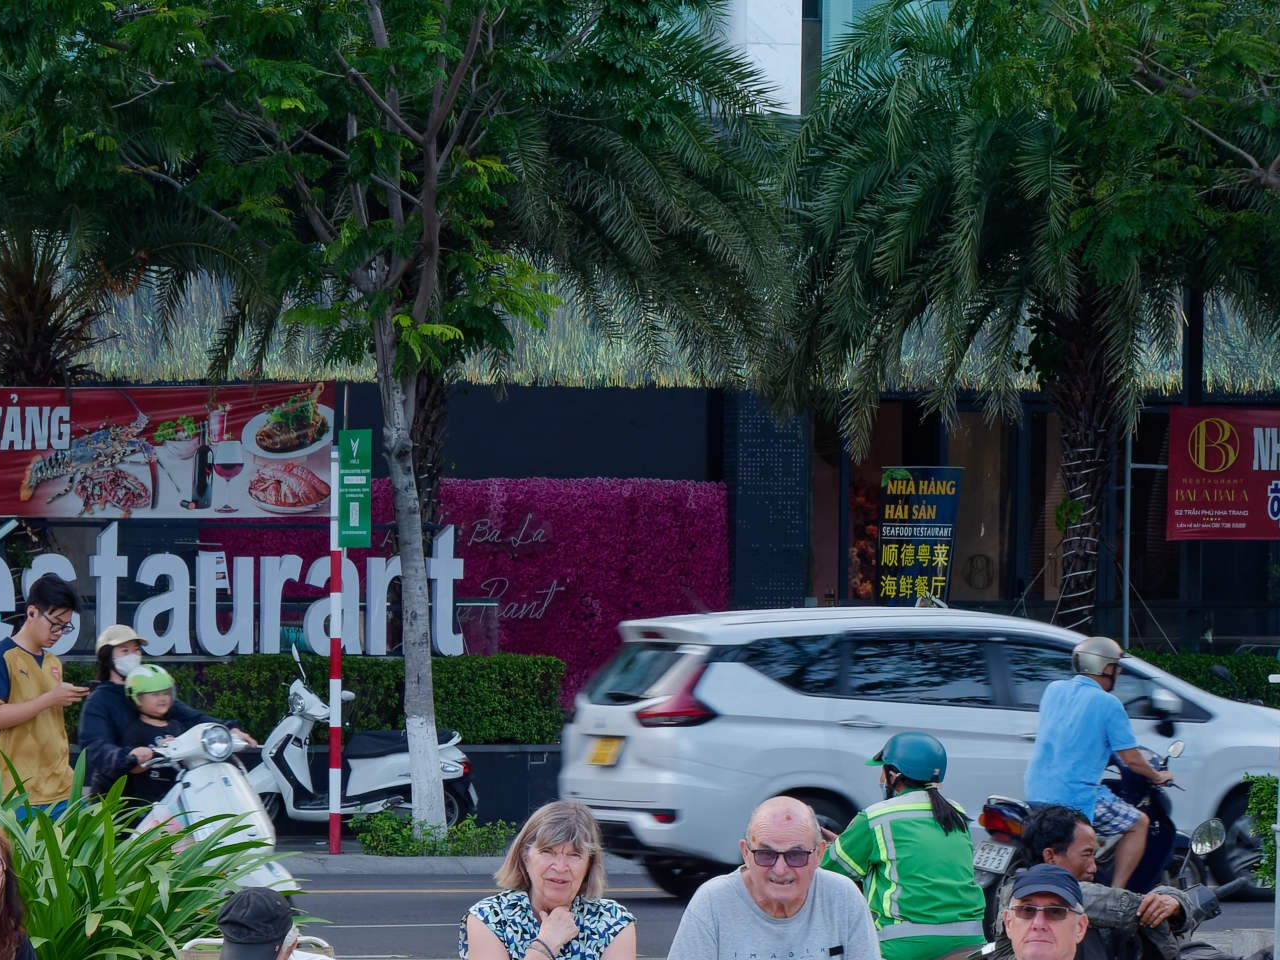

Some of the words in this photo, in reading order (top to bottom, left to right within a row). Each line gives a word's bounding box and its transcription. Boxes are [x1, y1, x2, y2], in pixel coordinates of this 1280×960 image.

[887, 477, 916, 495] NHÀ
[918, 477, 956, 495] HÀNG
[885, 500, 909, 519] HẢI
[912, 500, 937, 519] SẢN
[882, 526, 912, 537] SEAFOOD
[913, 527, 953, 537] RESTAURANT
[881, 543, 950, 566] 顺德粤菜
[880, 575, 946, 599] 海鲜餐厅
